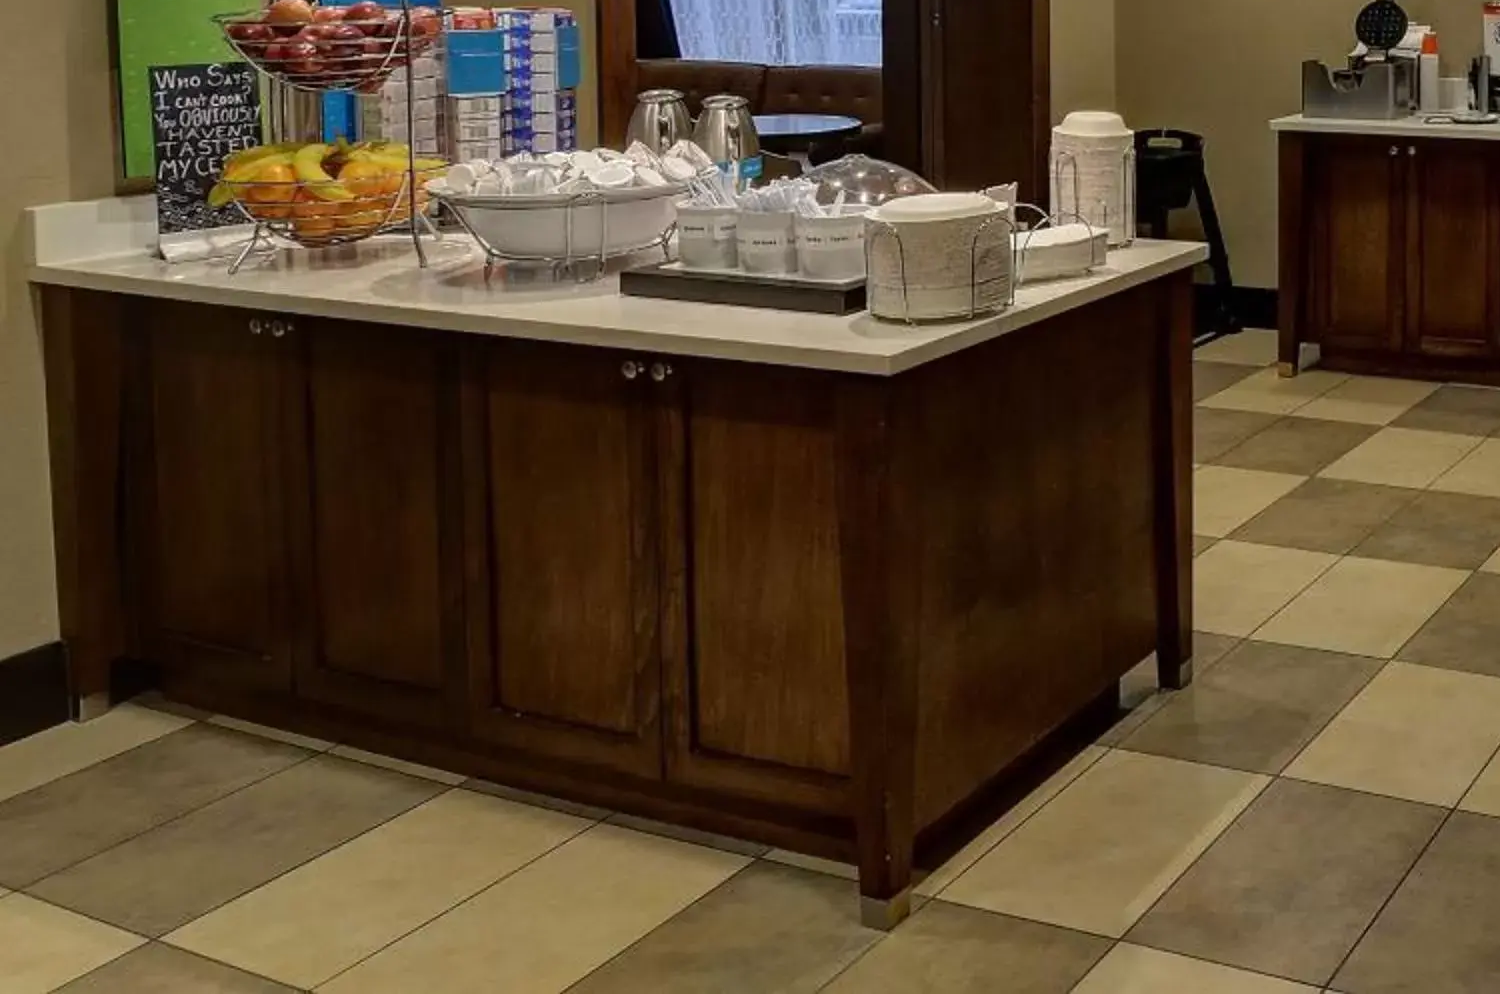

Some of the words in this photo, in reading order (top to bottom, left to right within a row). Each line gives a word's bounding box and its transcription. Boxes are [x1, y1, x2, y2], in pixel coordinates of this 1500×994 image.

[154, 91, 170, 110] I
[167, 123, 260, 141] HAVEN'T
[156, 135, 259, 159] TASTED
[158, 158, 191, 181] MY
